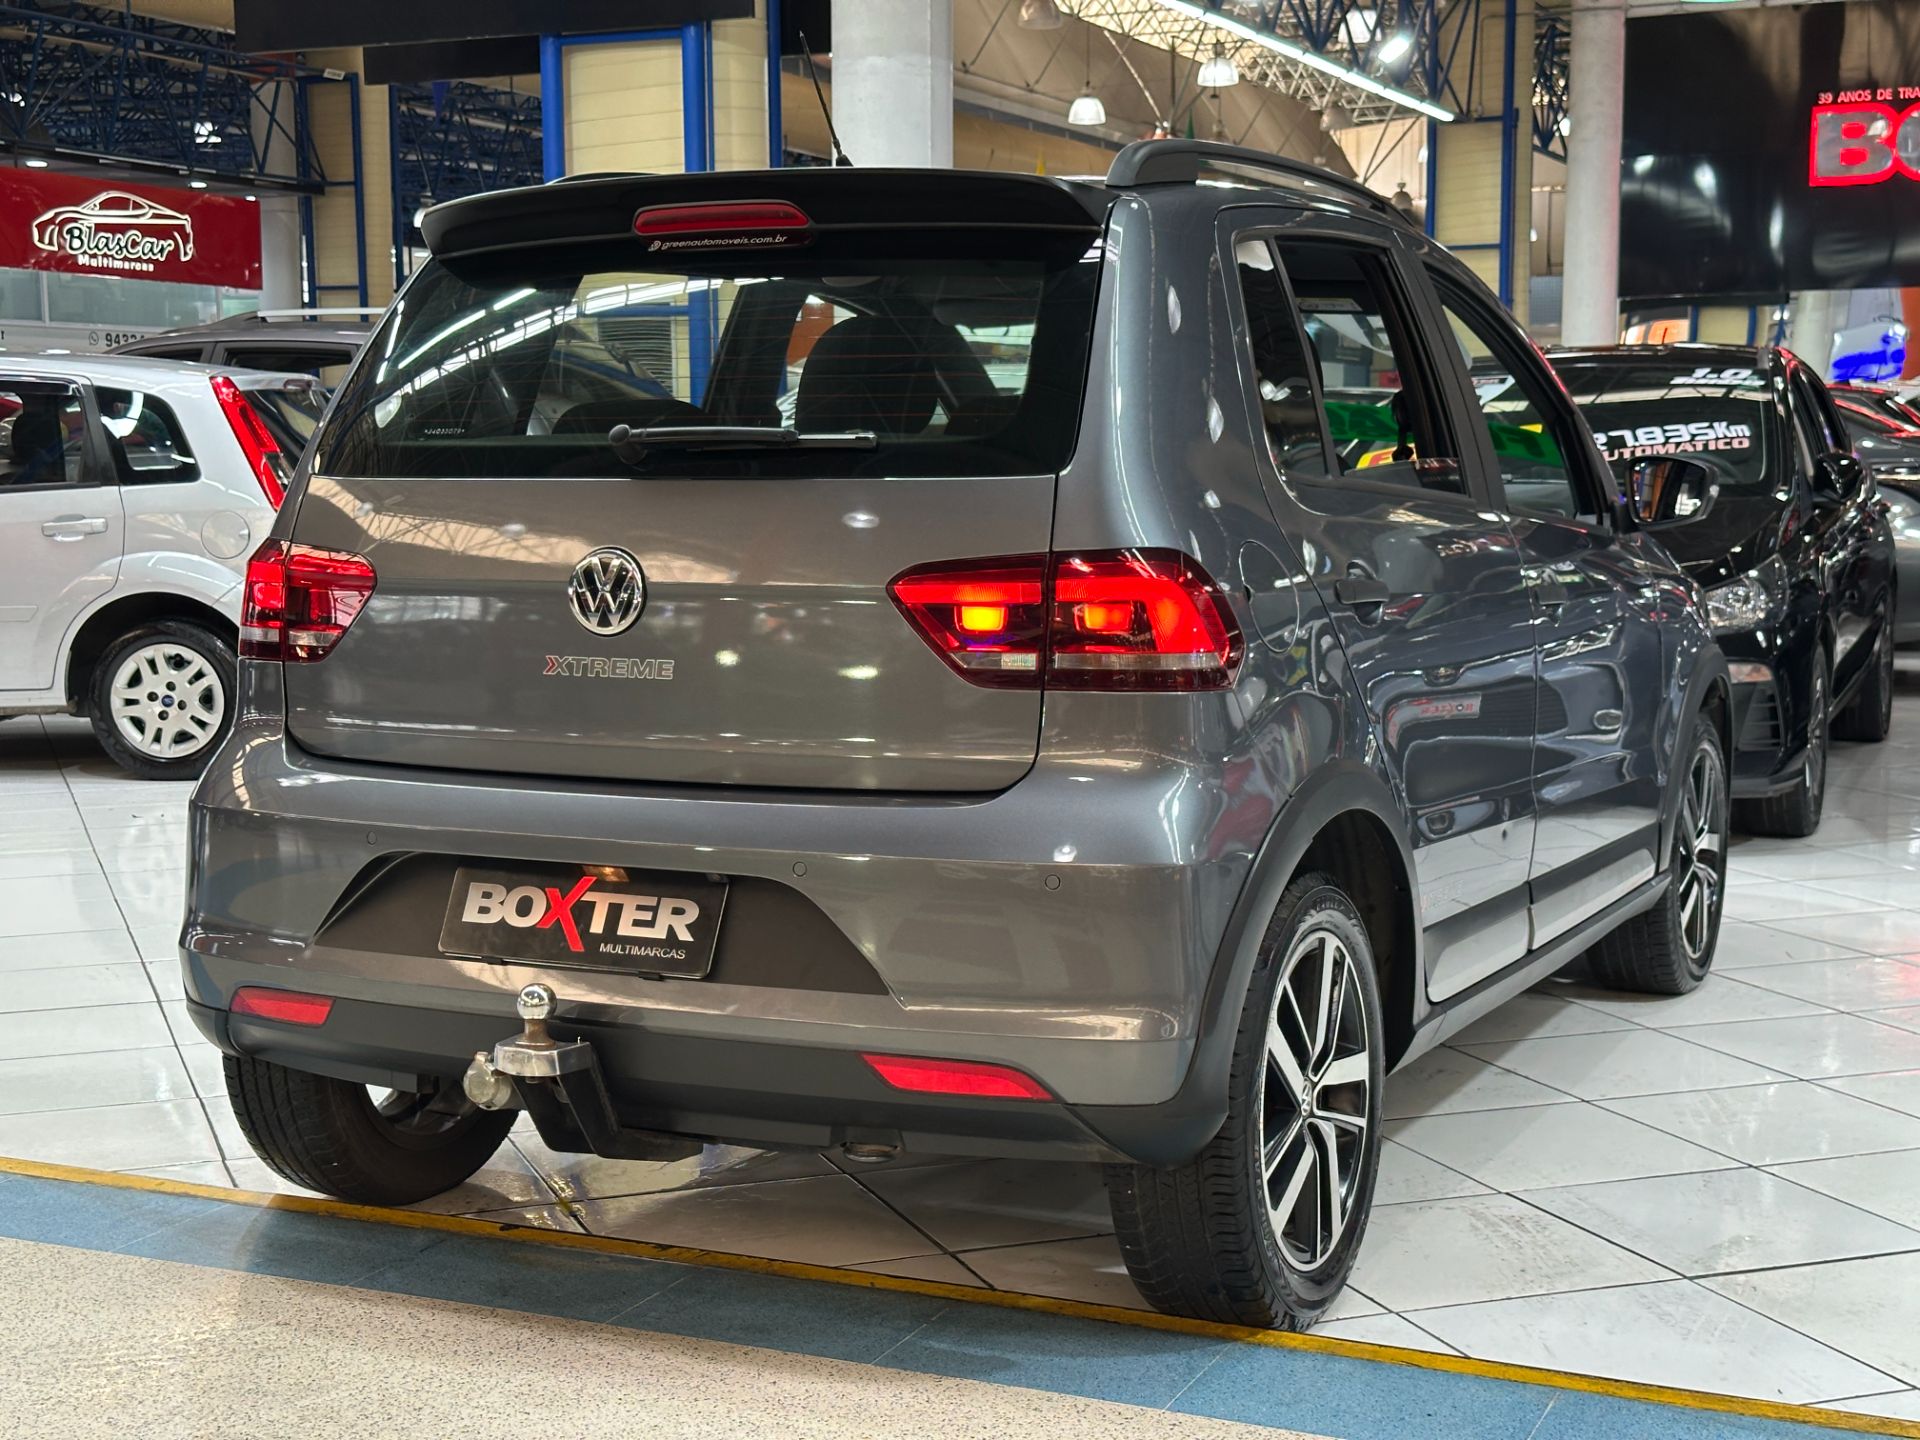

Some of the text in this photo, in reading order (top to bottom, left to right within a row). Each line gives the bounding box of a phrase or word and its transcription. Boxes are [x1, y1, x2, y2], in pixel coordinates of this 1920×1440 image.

[1817, 92, 1834, 104] 39
[1837, 89, 1872, 103] ANOS
[1876, 88, 1893, 100] DE
[65, 222, 175, 262] BlasCar
[661, 234, 787, 251] greenautomoveis.com.br
[77, 254, 154, 272] Multimarcas
[1690, 367, 1754, 380] 1.0
[1602, 437, 1750, 461] UTOMATICO
[543, 655, 675, 680] XTREME
[462, 875, 700, 952] BOXTER
[600, 942, 686, 960] MULTIMARCAS
